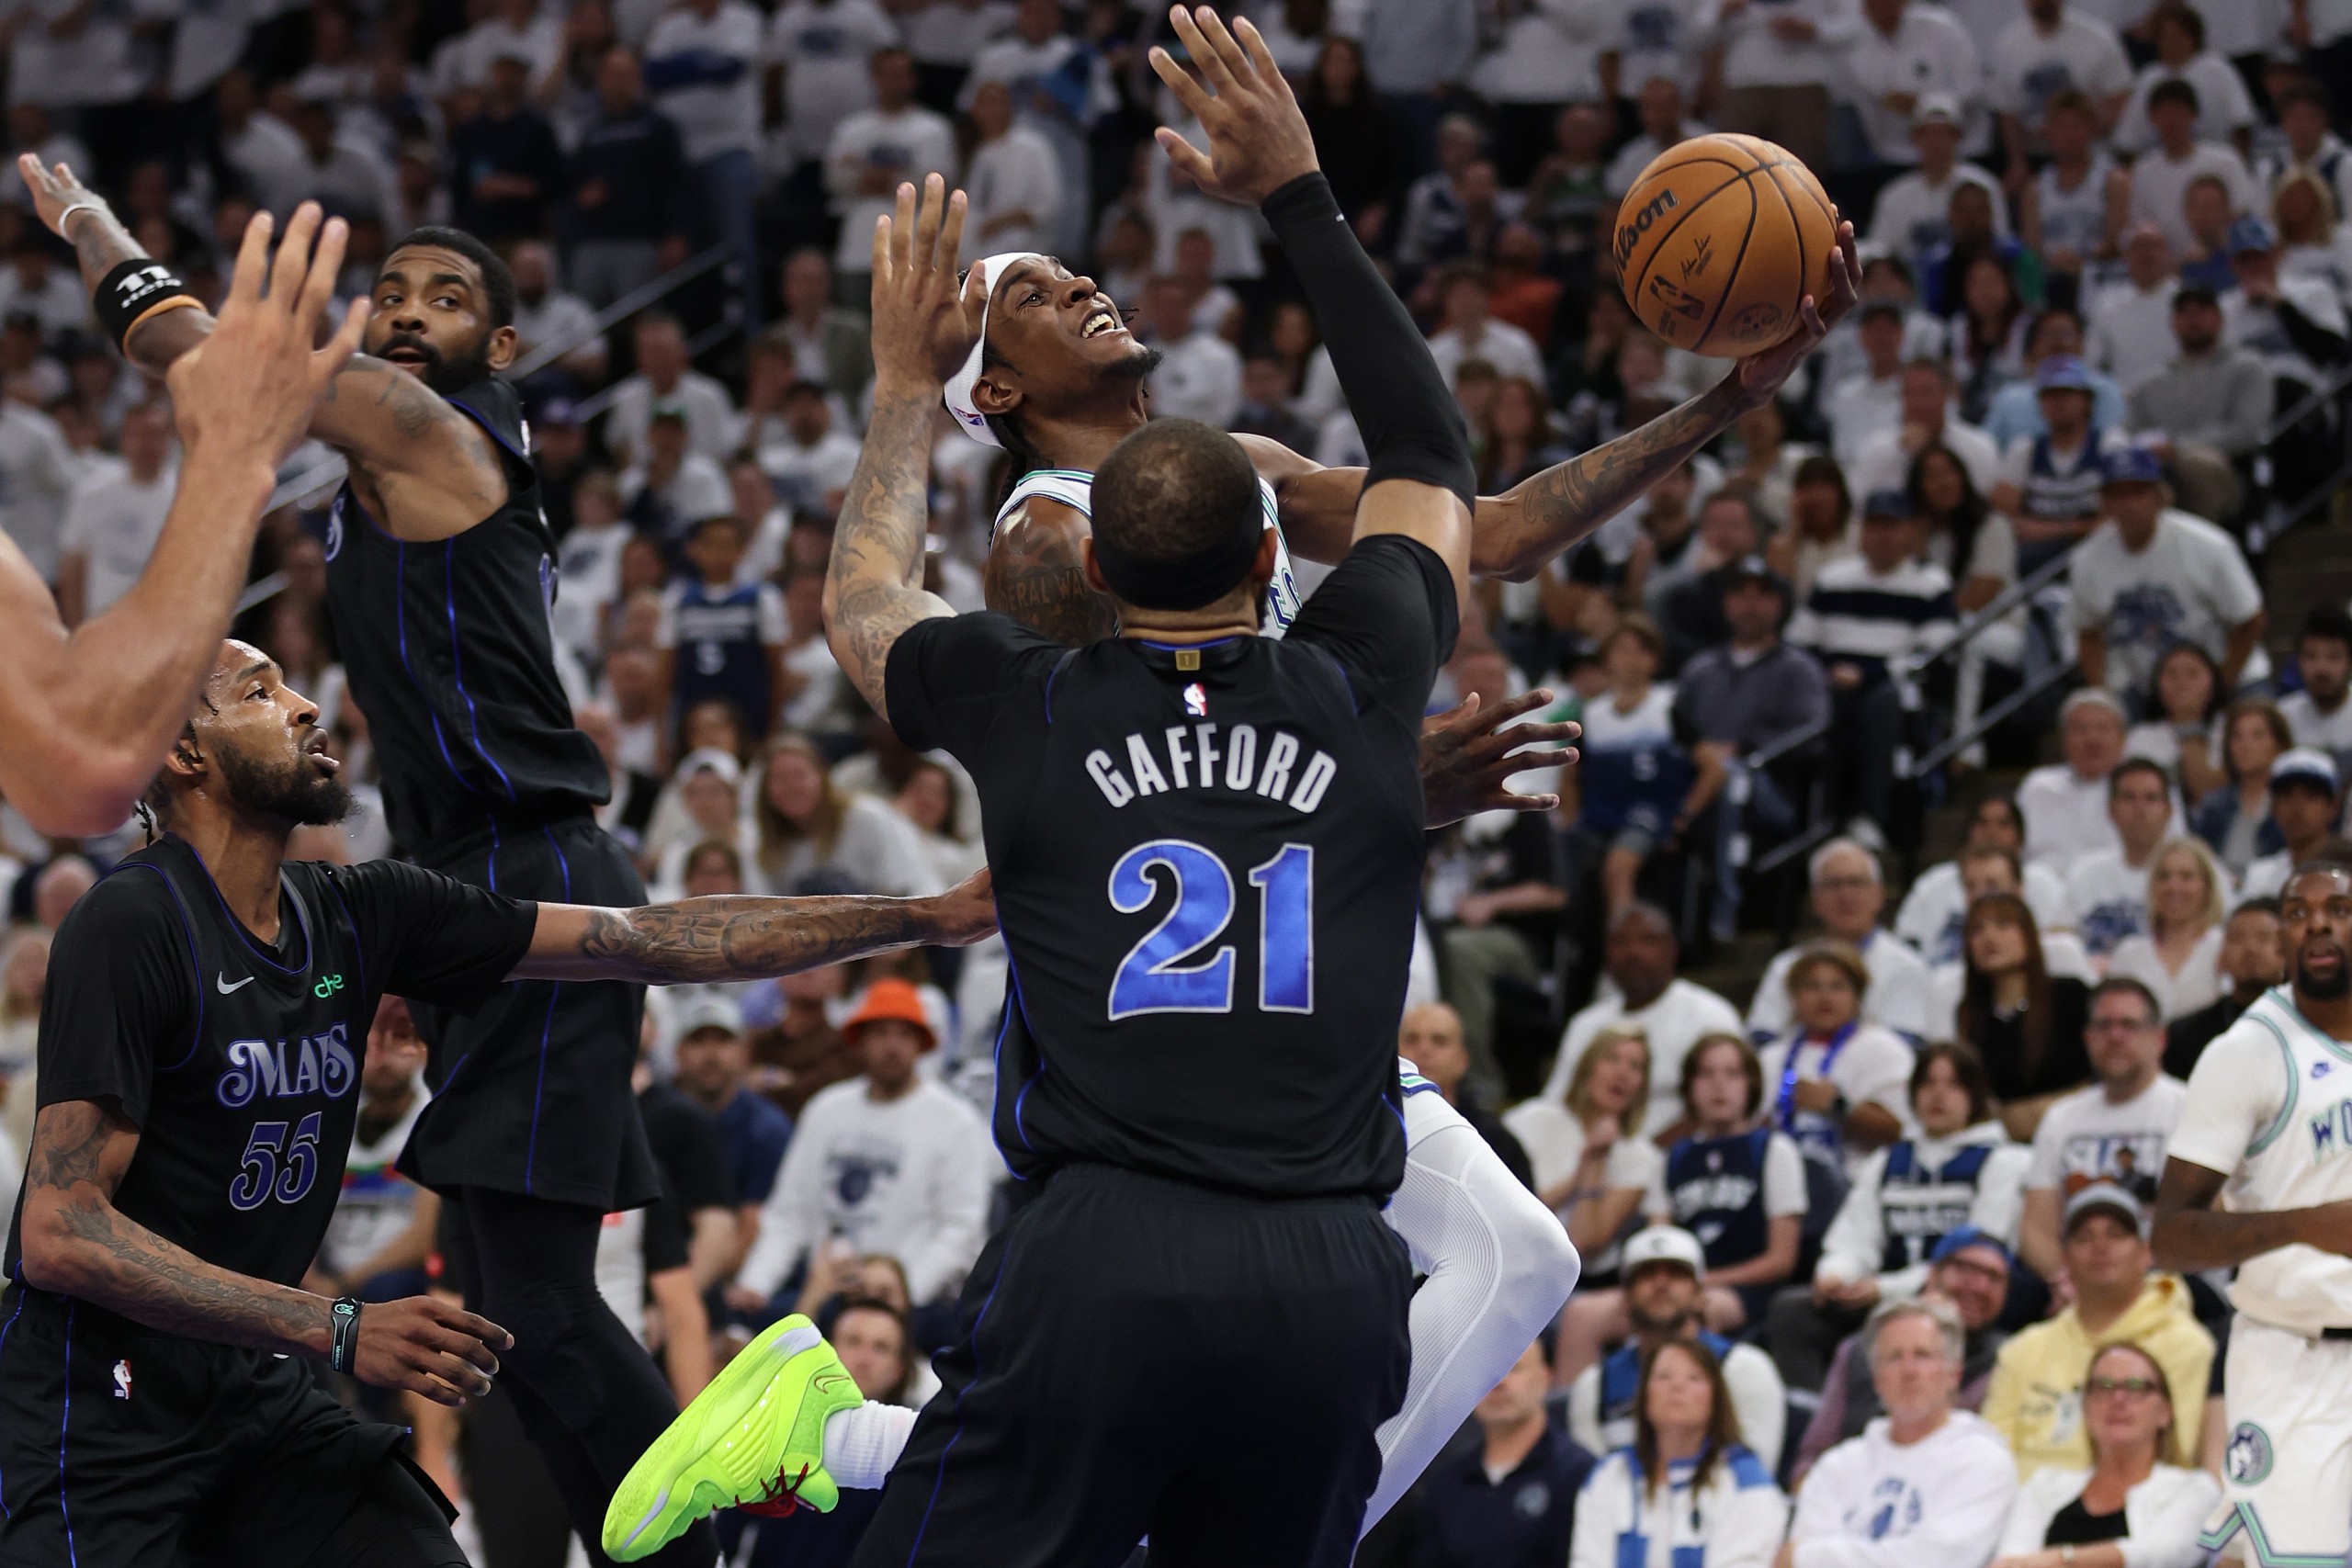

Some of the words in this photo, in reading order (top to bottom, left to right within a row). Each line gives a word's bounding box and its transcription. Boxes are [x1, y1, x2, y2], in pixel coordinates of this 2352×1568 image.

[115, 265, 171, 293] 11
[1615, 188, 1679, 281] ilson
[1085, 722, 1337, 814] GAFFORD
[1108, 838, 1314, 1021] 21
[230, 1111, 322, 1211] 55
